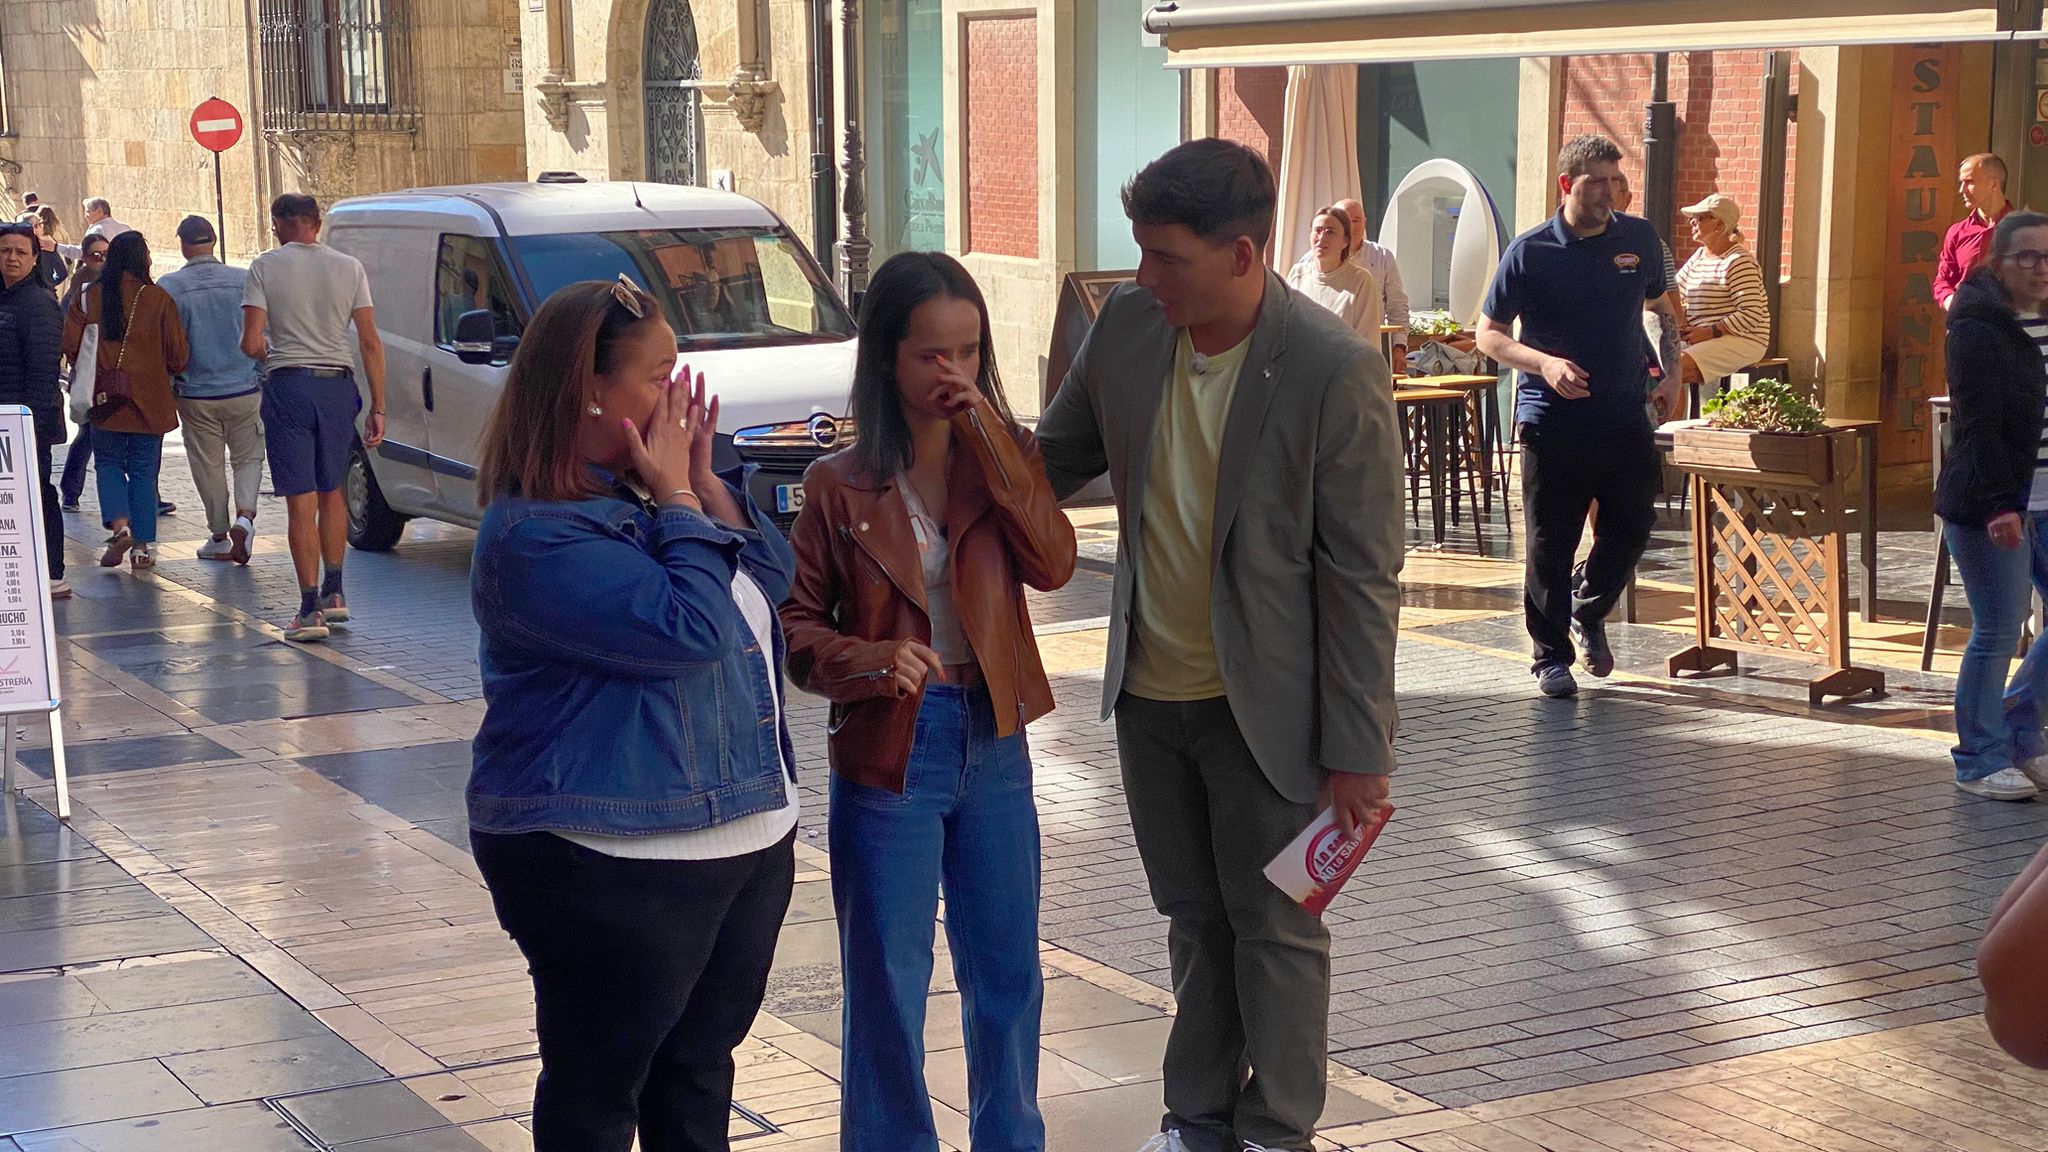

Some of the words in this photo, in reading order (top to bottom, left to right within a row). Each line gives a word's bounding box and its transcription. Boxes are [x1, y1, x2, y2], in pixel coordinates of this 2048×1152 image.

[1898, 42, 1944, 431] STAURANTE
[1319, 866, 1337, 884] NO
[1332, 857, 1345, 869] LO
